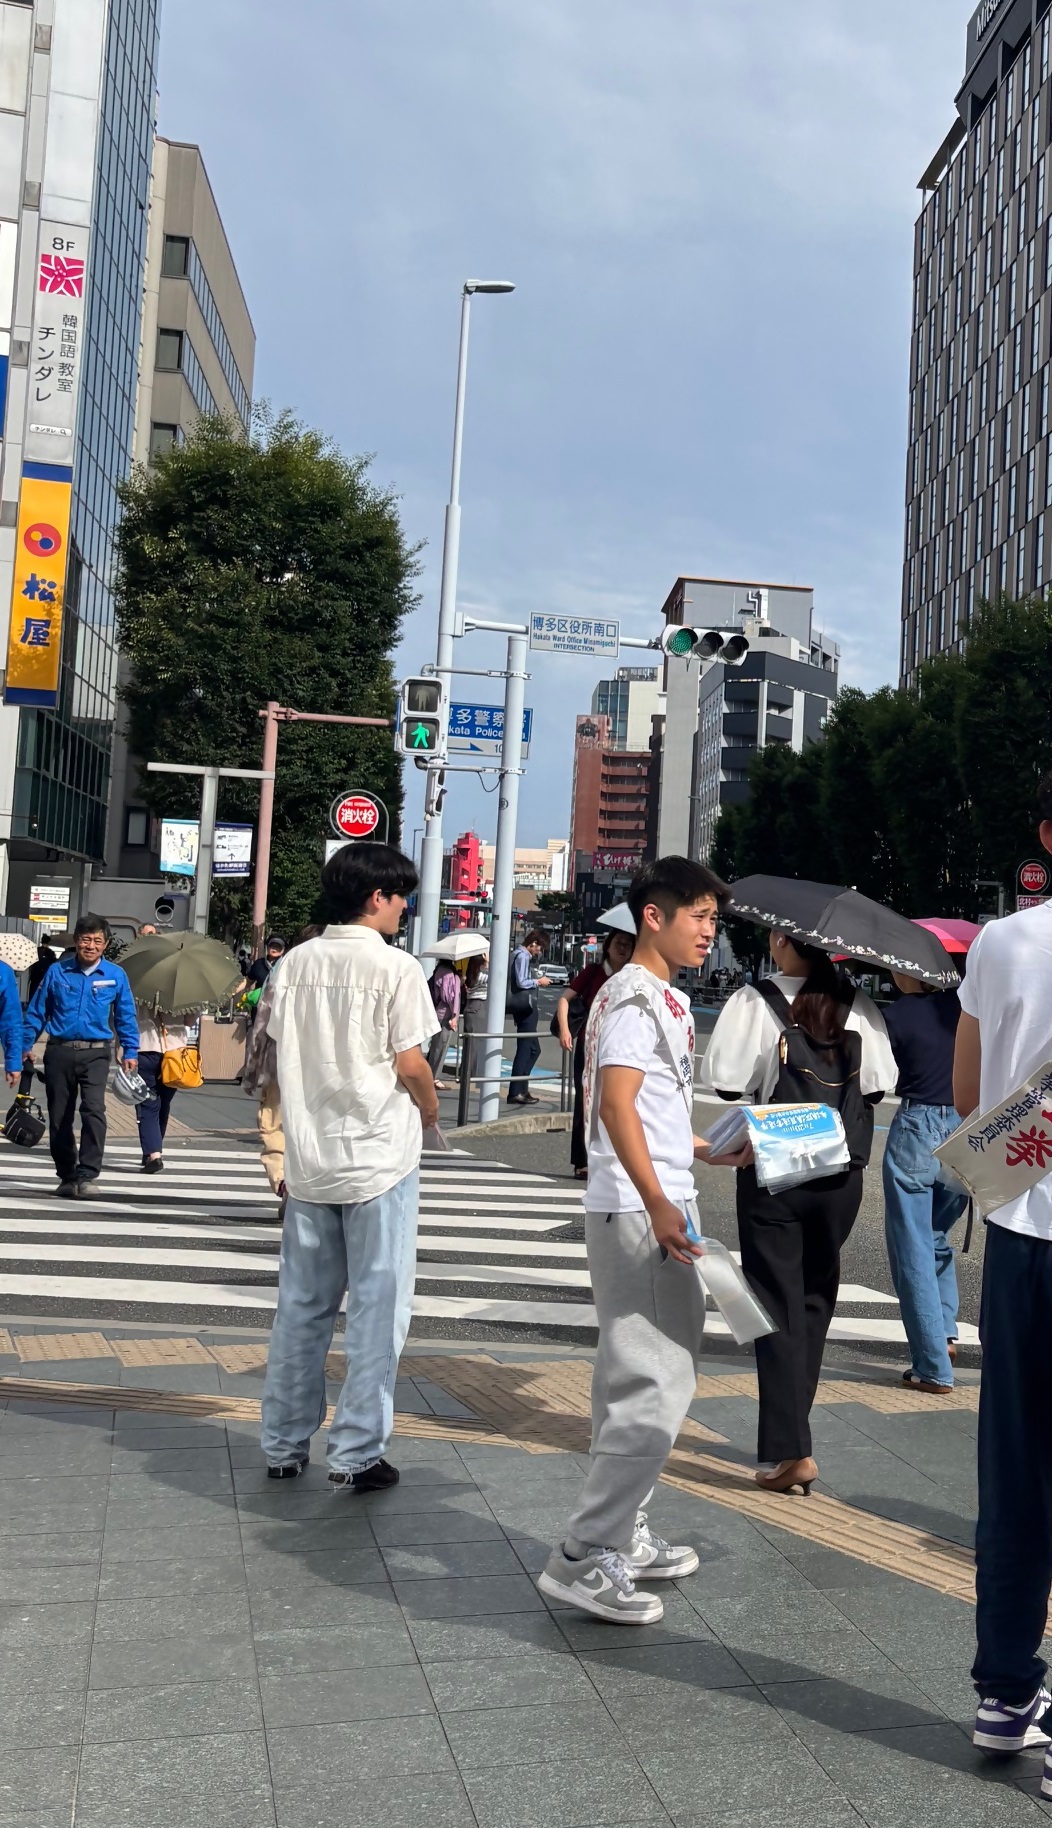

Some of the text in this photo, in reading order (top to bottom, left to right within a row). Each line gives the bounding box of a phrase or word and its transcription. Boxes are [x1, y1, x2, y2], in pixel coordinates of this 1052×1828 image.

[52, 237, 75, 252] 8F
[35, 326, 56, 402] チンダレ
[20, 573, 57, 647] 松屋
[533, 616, 617, 638] 博多区役所南口
[533, 632, 616, 648] Hakata Ward Office Minamiguchi
[553, 643, 595, 652] INTERSECTION
[450, 706, 527, 729] 多警察
[341, 808, 375, 825] 消火栓
[1023, 871, 1045, 883] 消火栓
